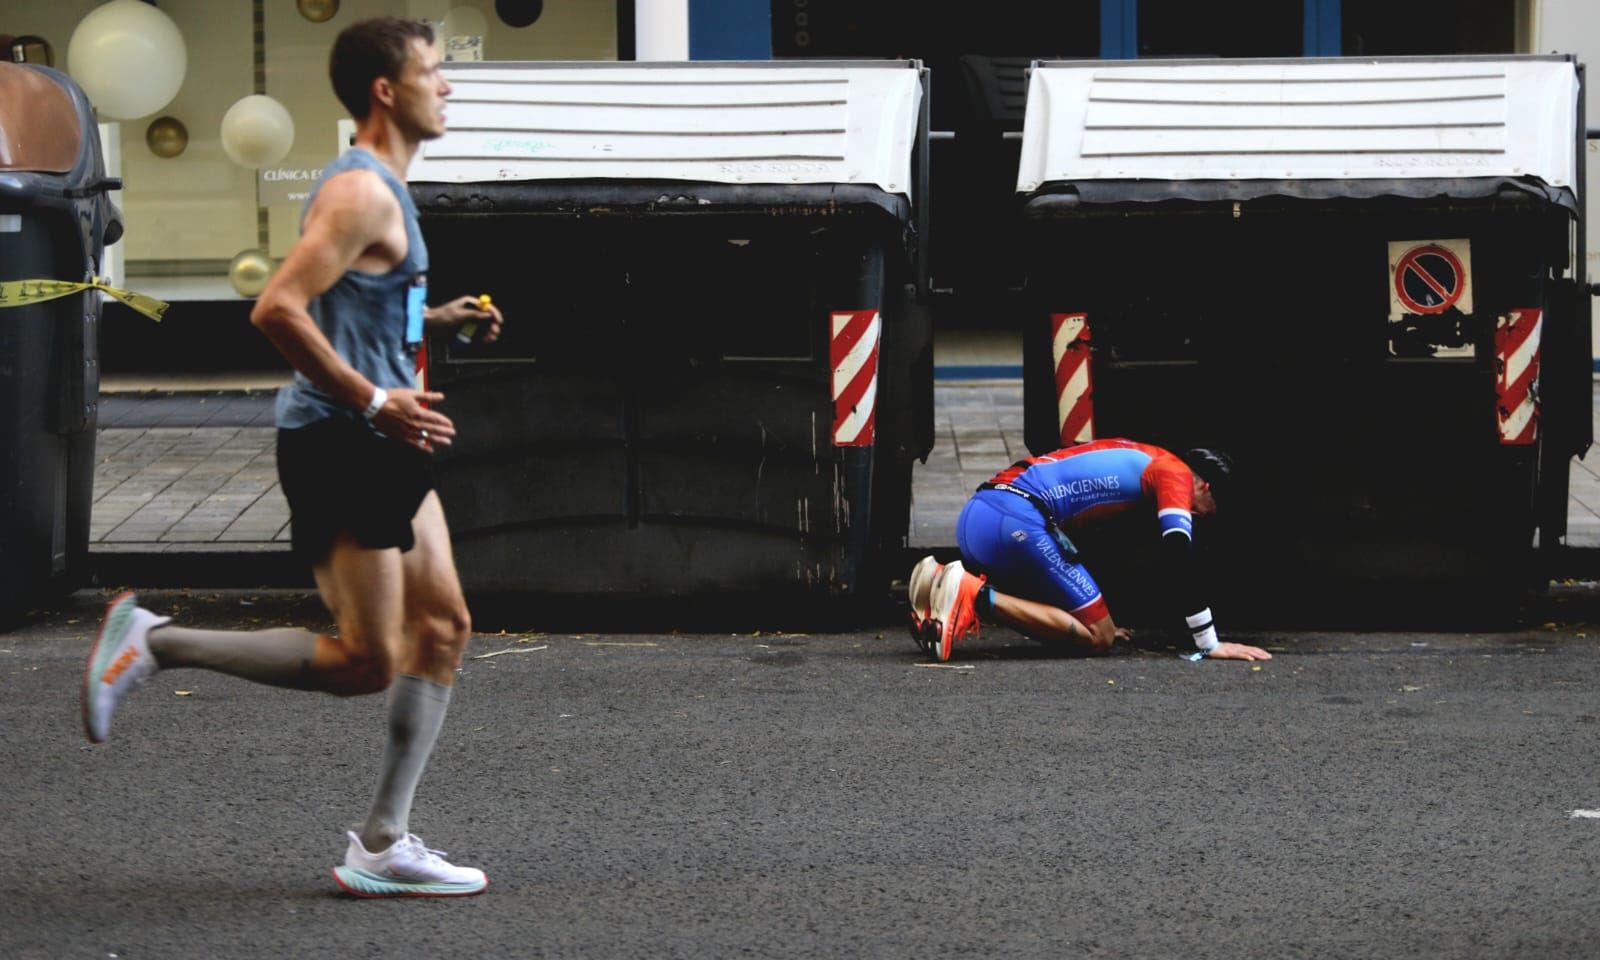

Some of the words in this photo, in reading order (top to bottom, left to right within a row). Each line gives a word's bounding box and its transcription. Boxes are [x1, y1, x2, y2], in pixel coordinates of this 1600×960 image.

[263, 168, 309, 182] CLÍNICA
[1041, 475, 1121, 501] VALENCIENNES
[1036, 536, 1096, 597] VALENCIENNES
